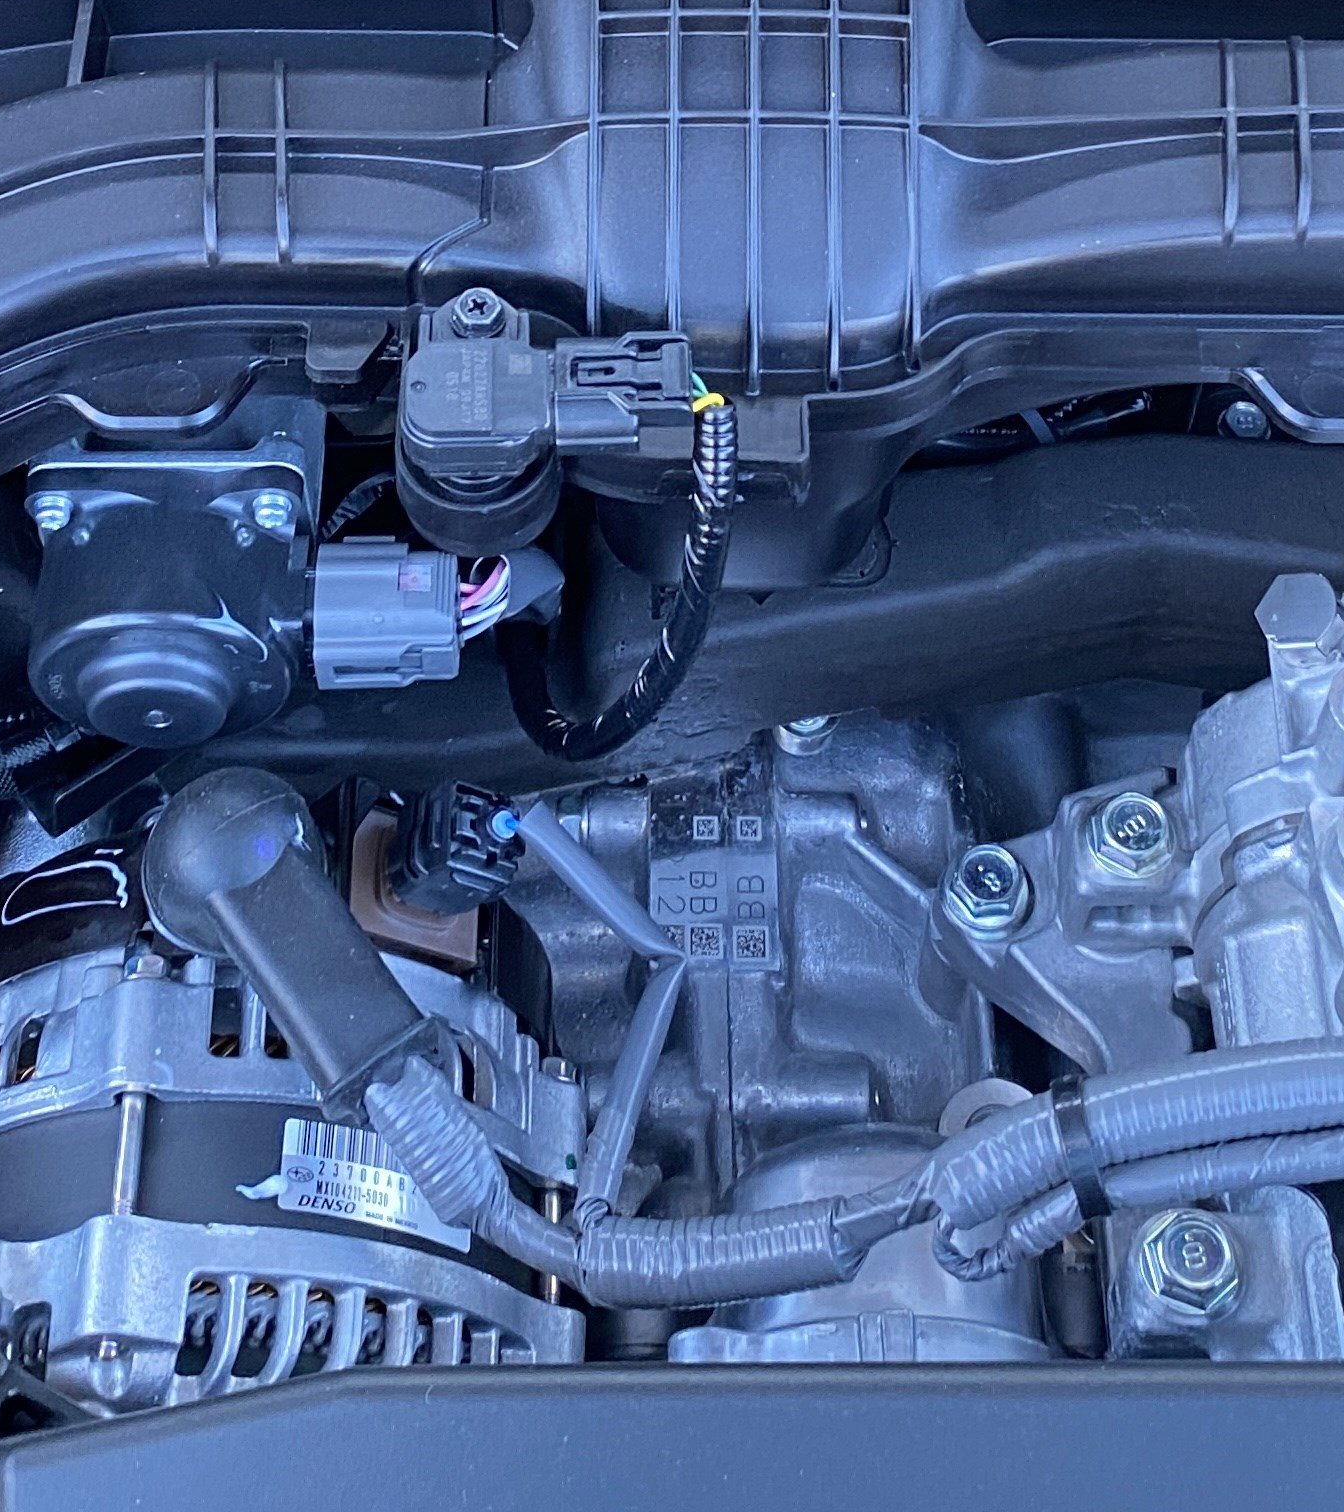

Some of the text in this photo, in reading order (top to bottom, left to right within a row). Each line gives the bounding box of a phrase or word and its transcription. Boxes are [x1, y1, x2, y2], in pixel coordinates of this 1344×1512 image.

[658, 874, 687, 915] 12
[689, 871, 718, 915] BB
[298, 1194, 357, 1214] DENSO
